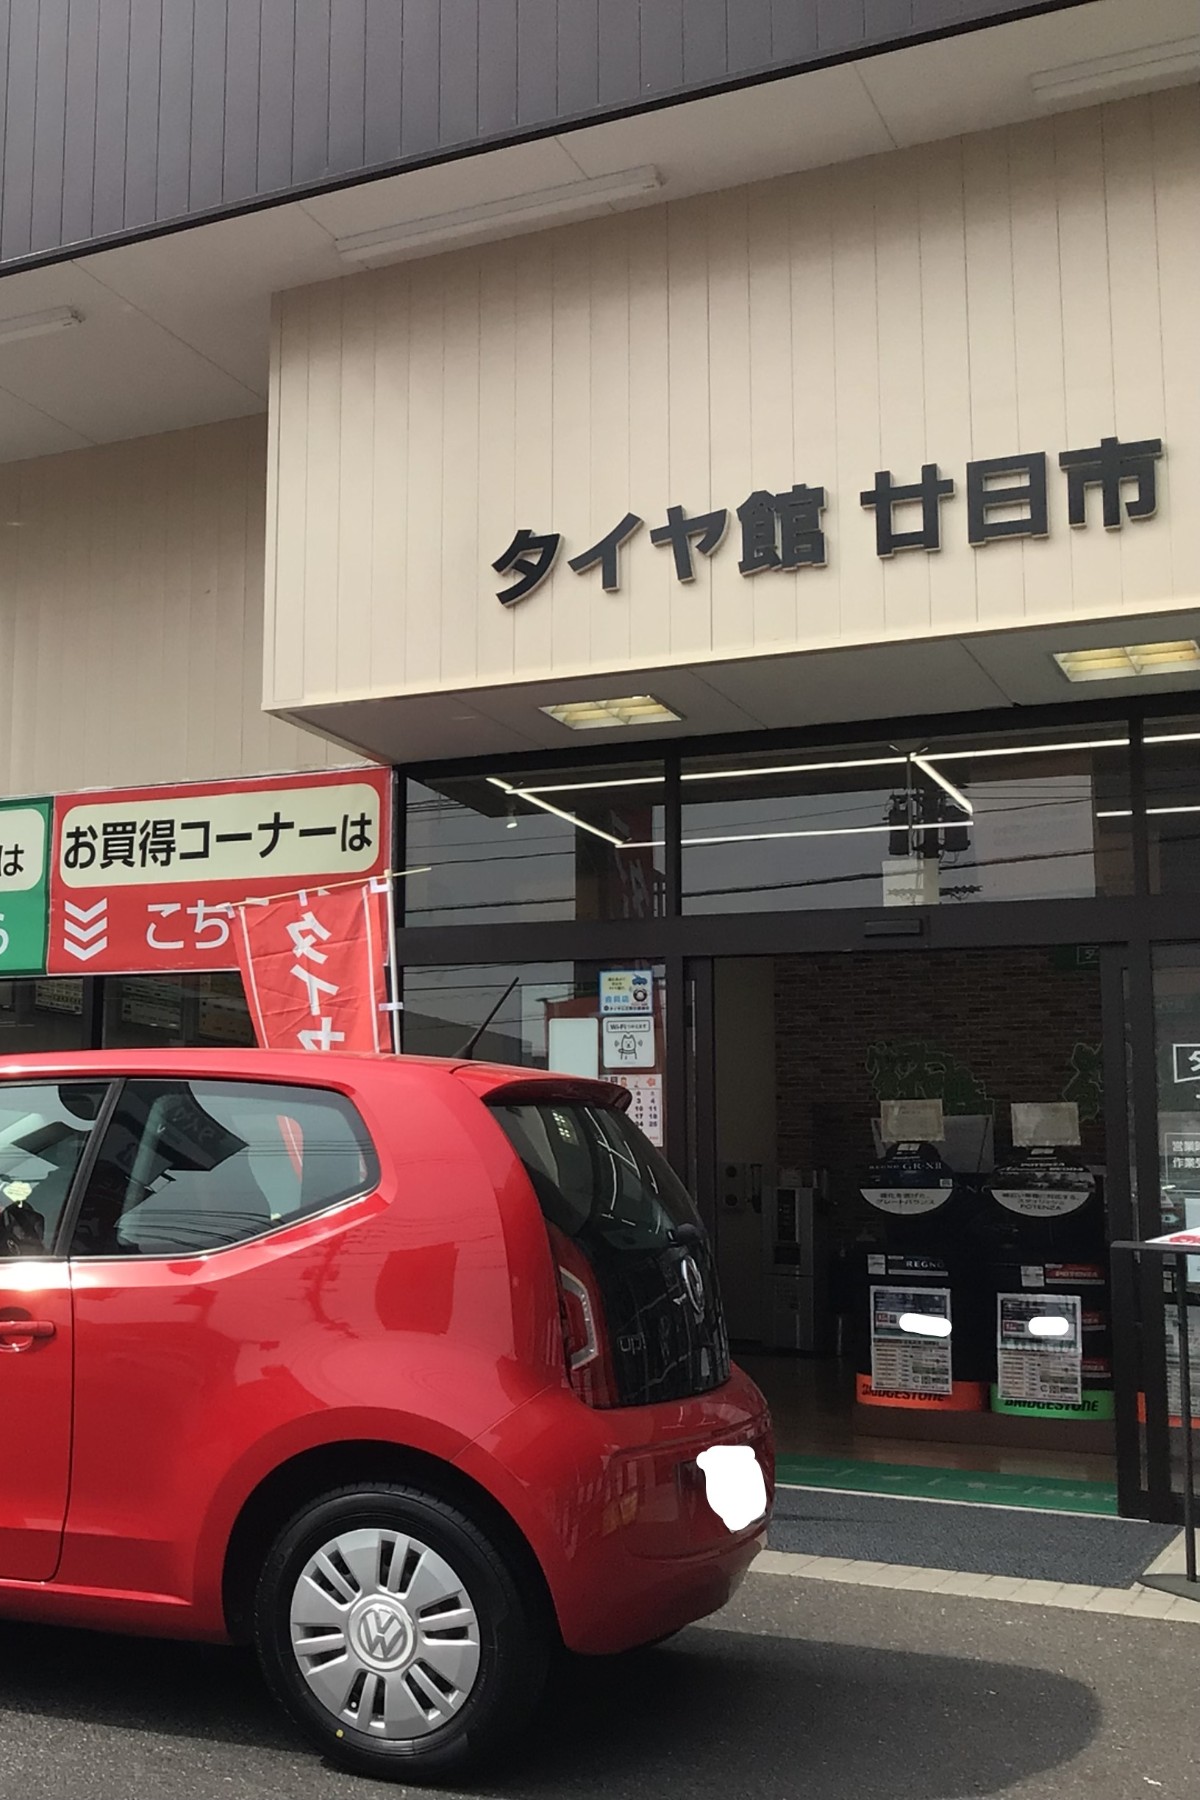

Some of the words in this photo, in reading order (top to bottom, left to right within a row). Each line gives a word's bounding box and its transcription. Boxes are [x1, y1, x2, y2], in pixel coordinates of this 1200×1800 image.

[492, 484, 828, 607] タイヤ館
[860, 436, 1163, 558] 廿日市
[64, 811, 373, 870] お買得コーナーは
[146, 897, 268, 951] こち
